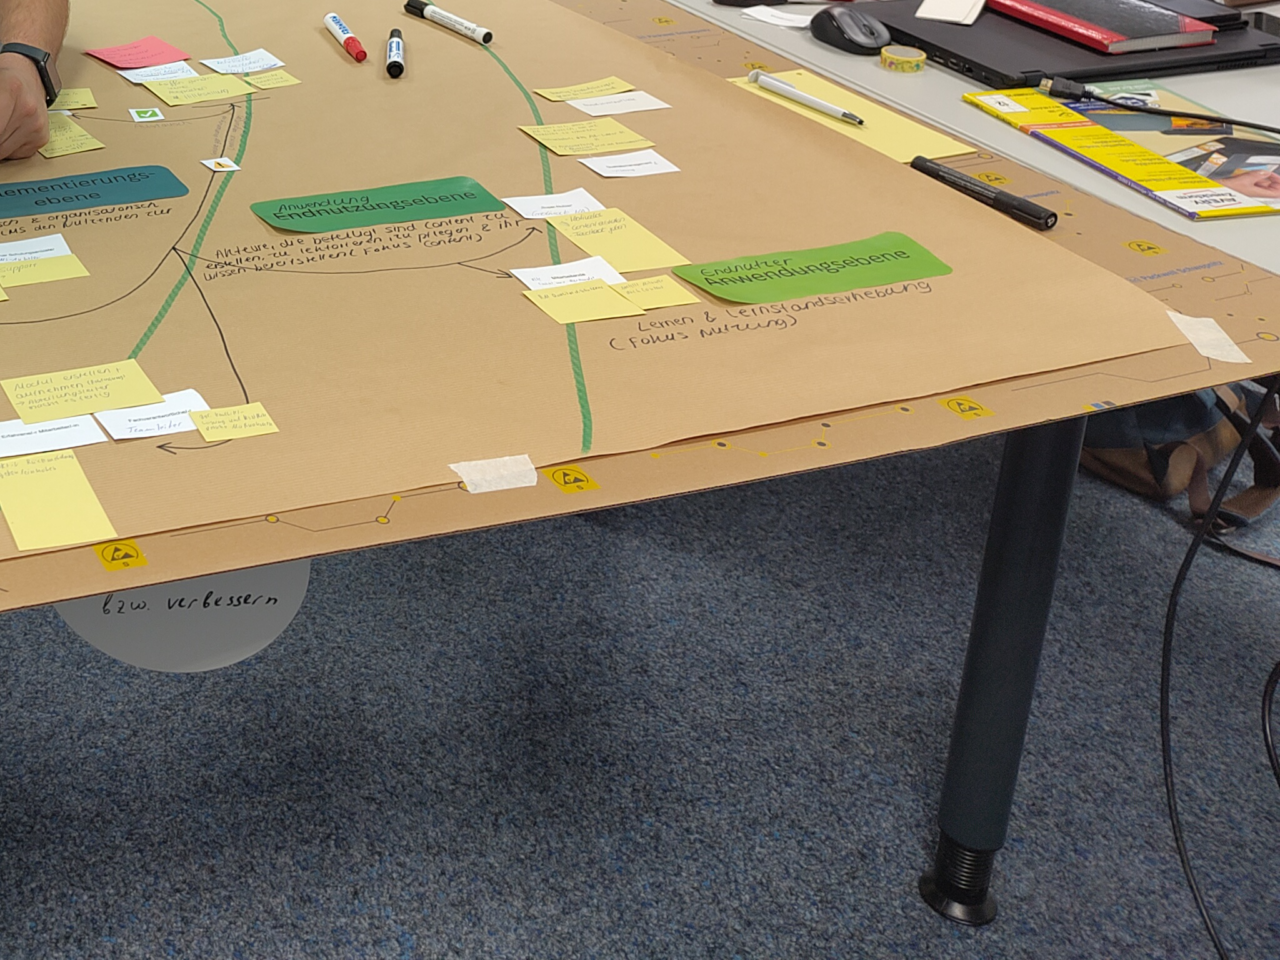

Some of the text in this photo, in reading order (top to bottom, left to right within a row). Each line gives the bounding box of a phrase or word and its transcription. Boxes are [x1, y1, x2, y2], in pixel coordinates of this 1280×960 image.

[34, 190, 102, 208] ebene
[273, 191, 478, 221] Endnutzungsebene
[278, 196, 369, 213] Anwendung
[279, 238, 305, 249] die
[384, 224, 417, 234] sind
[701, 257, 793, 277] Endnutzer
[704, 249, 910, 287] Anwendungsebene
[638, 316, 694, 332] Lernen
[704, 311, 717, 323] &
[14, 377, 53, 392] Modul
[102, 590, 279, 615] bzw. verbessern
